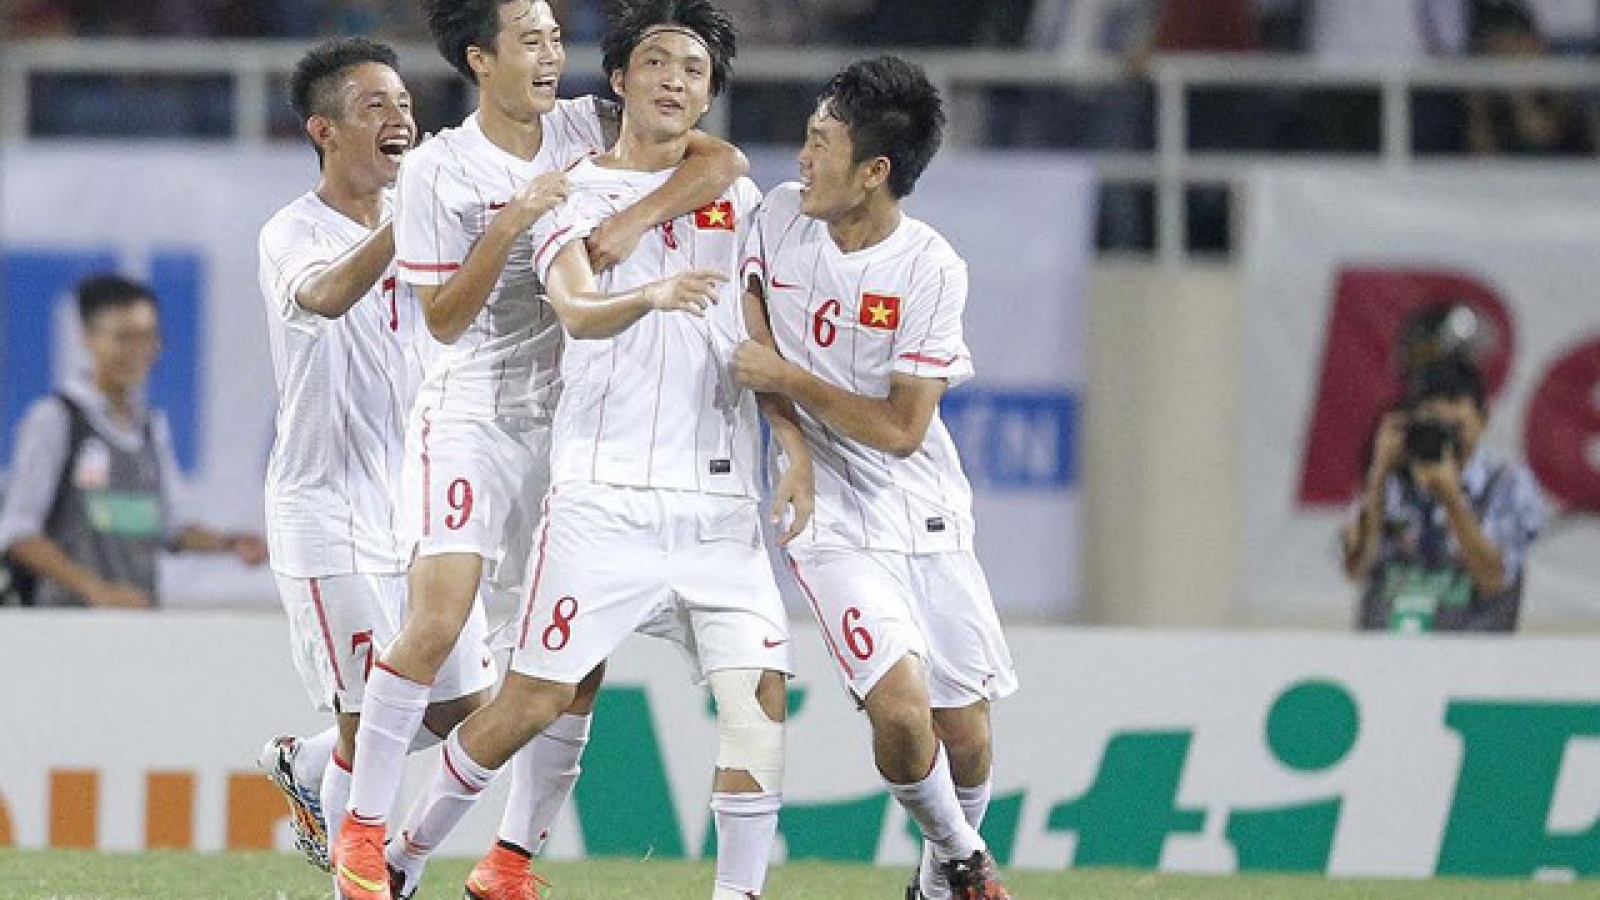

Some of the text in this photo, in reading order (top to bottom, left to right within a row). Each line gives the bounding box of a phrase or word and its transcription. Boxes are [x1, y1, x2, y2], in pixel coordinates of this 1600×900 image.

[812, 299, 841, 348] 6
[446, 478, 473, 530] 9
[542, 596, 578, 651] 8
[841, 607, 874, 660] 6
[352, 630, 373, 683] 7
